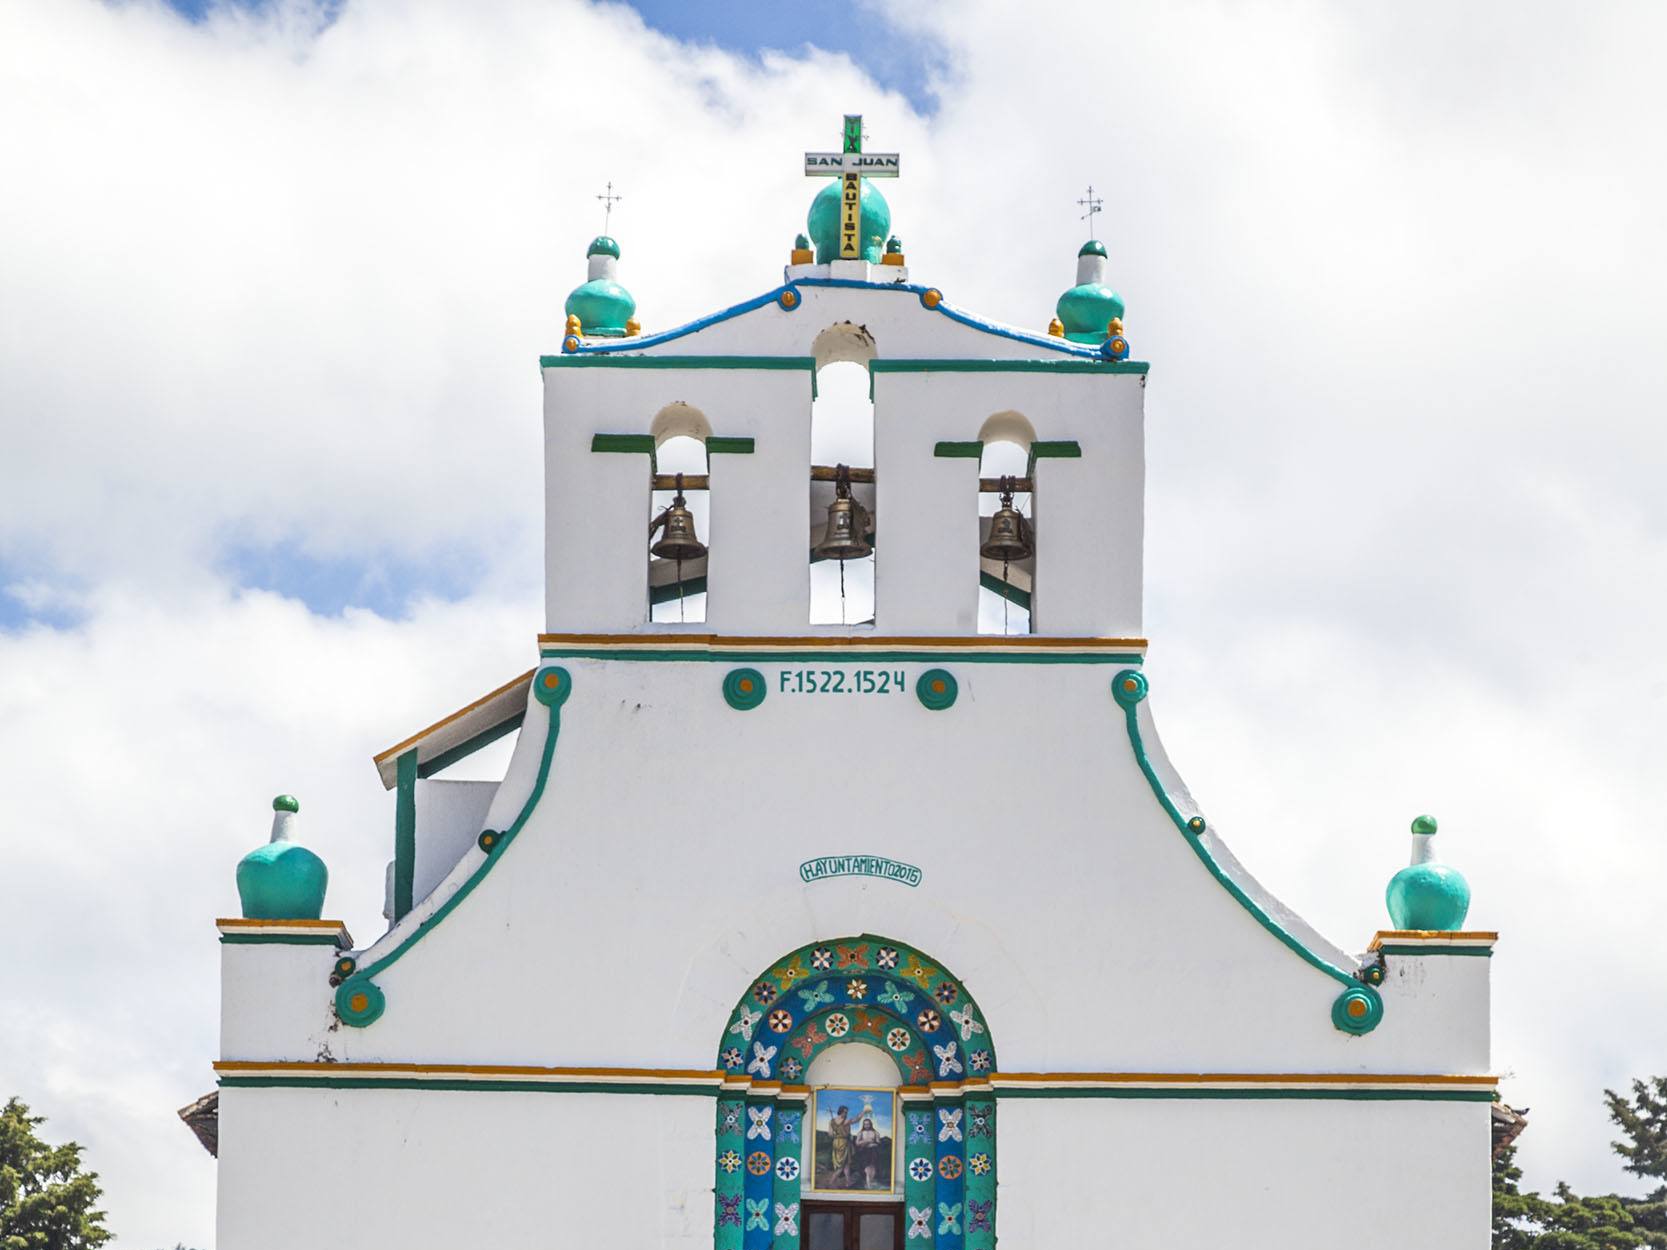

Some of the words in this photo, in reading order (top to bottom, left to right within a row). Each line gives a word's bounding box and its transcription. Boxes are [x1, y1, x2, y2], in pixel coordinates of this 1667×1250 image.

[807, 157, 843, 166] SAN
[852, 158, 898, 167] JUAN
[843, 172, 858, 252] BAUTISTA
[780, 670, 905, 693] F.1522.1524
